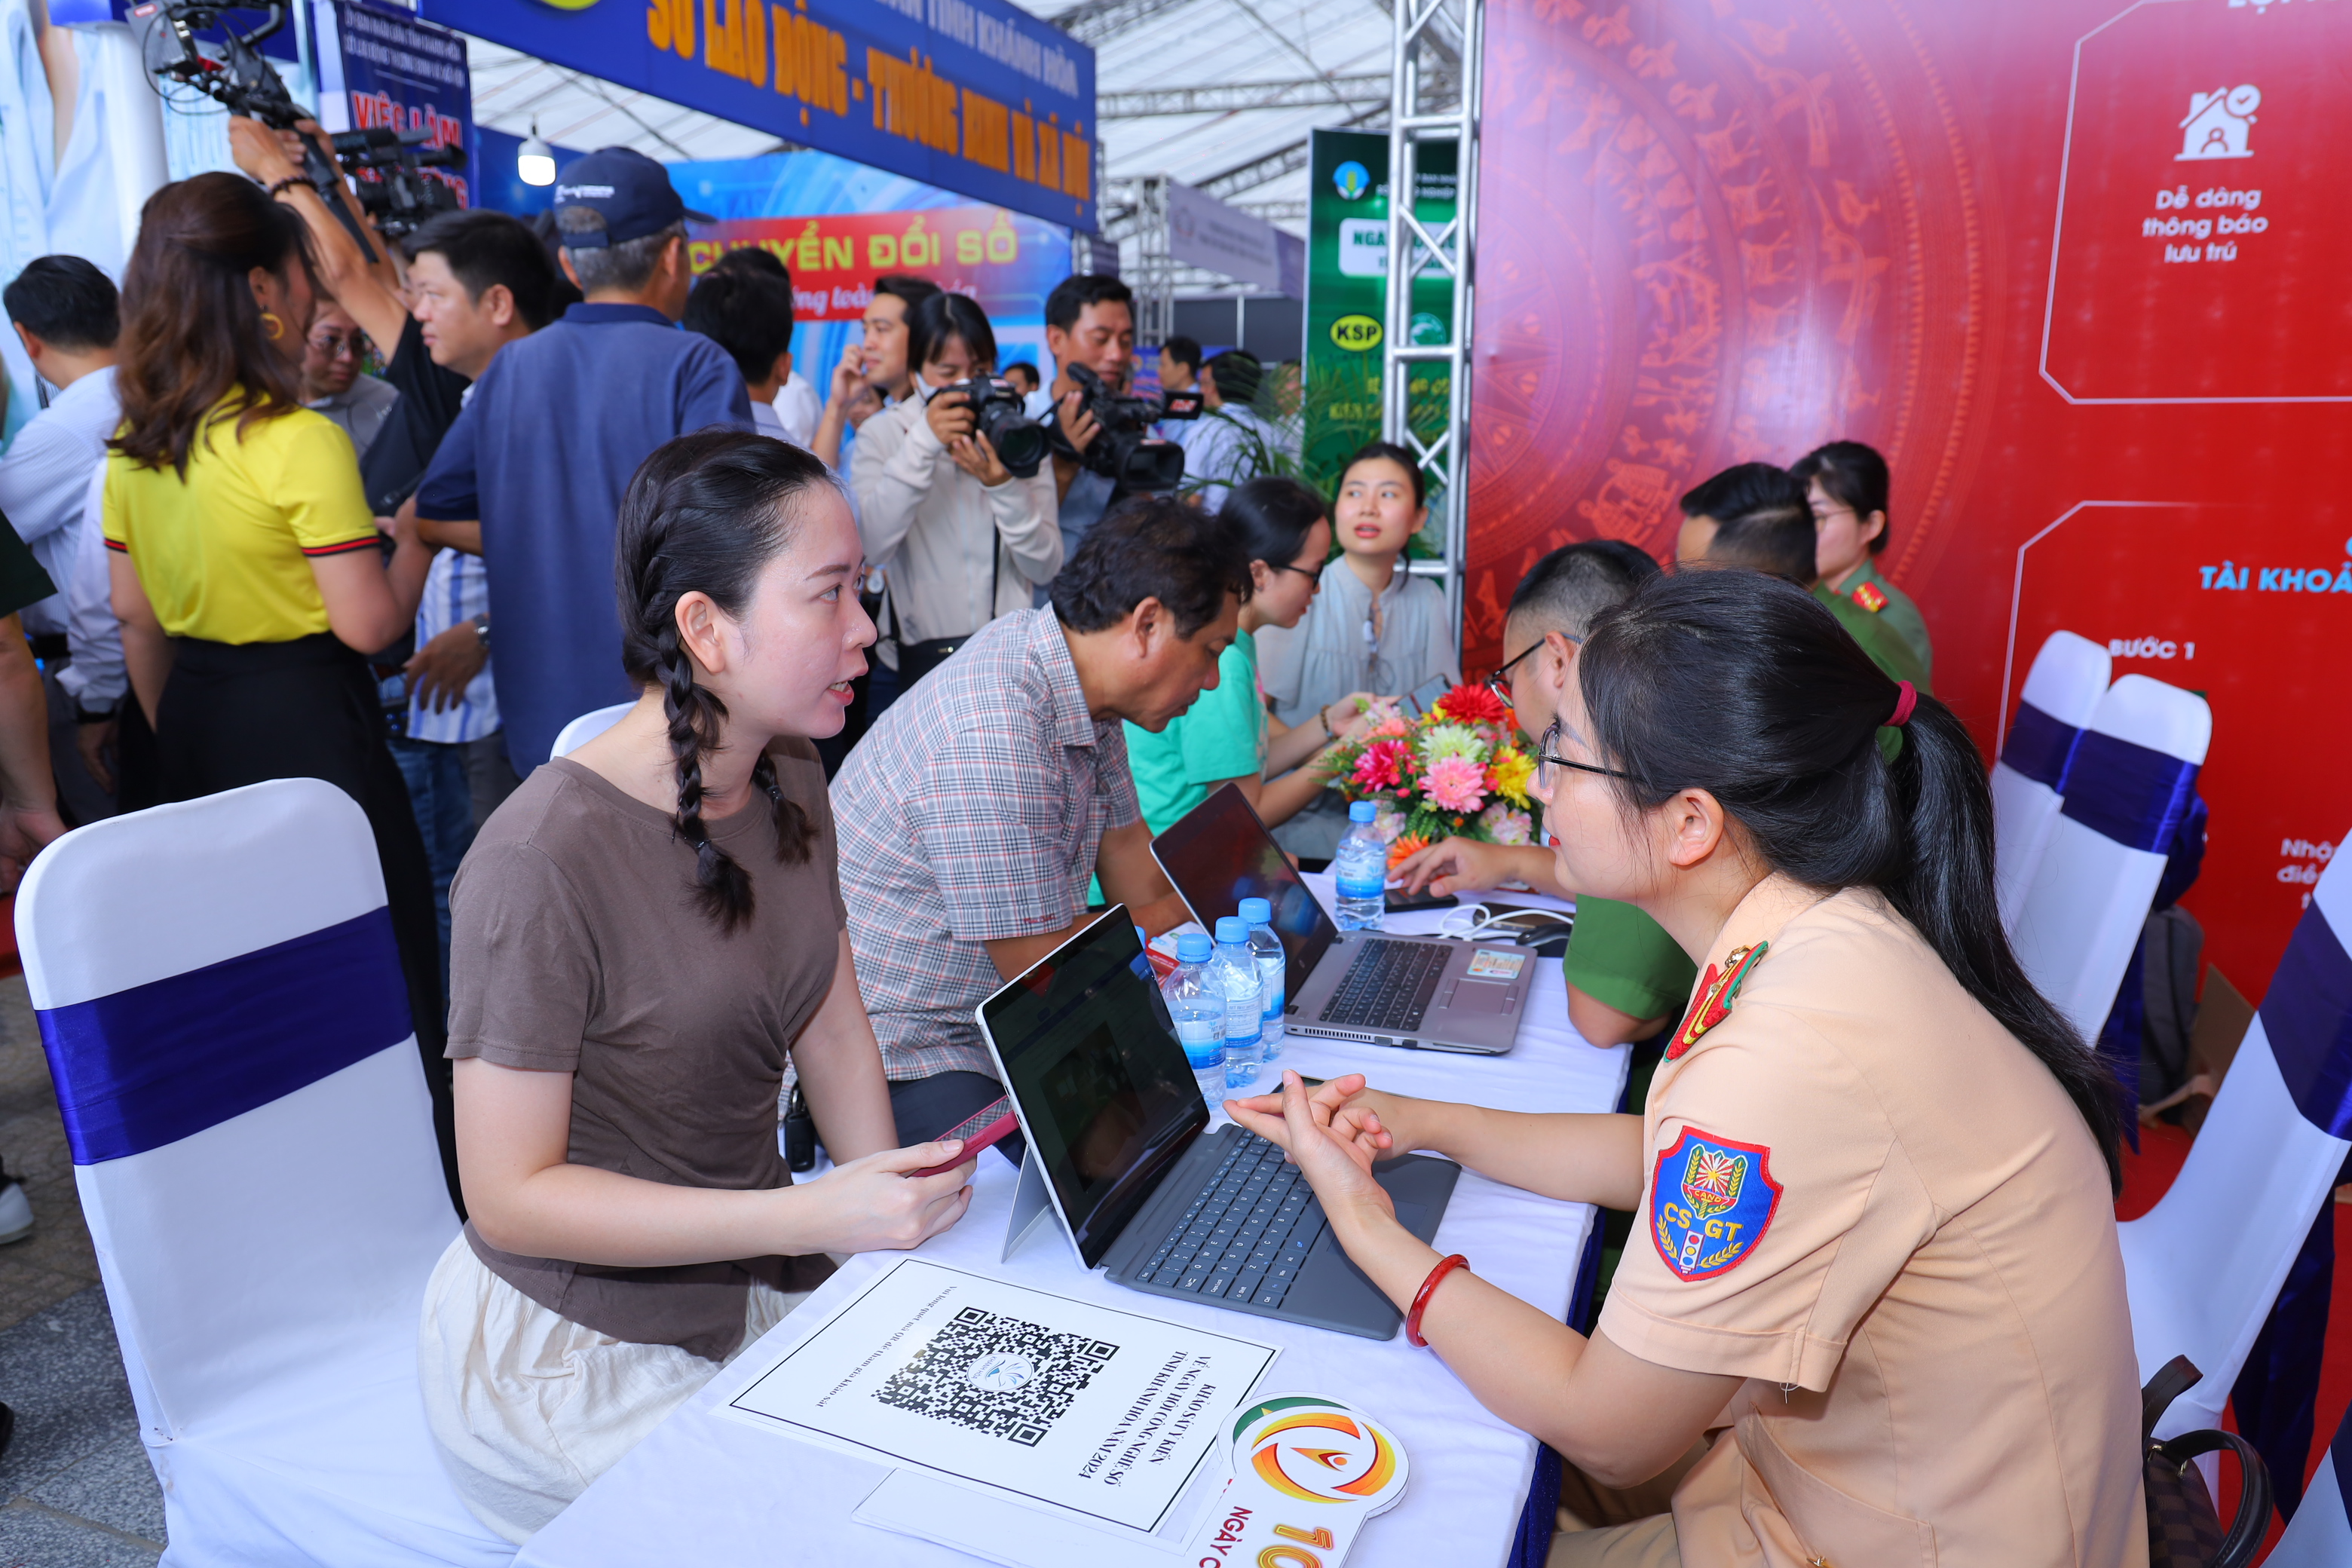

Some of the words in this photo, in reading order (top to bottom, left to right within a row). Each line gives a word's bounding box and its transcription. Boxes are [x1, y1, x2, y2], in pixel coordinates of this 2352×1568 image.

[2155, 185, 2189, 210] Dễ
[2195, 186, 2262, 211] dàng
[2142, 216, 2213, 239] thông
[2217, 213, 2268, 234] báo
[688, 219, 854, 275] CYỂN
[868, 215, 942, 268] ĐỔI
[957, 208, 1018, 265] SỐ
[2164, 243, 2201, 263] lưu
[2206, 240, 2237, 262] trú
[1337, 325, 1377, 341] KSP
[2199, 559, 2250, 590] TÀI
[2257, 561, 2352, 594] KHOẢ
[2110, 635, 2178, 659] BƯỚC
[2183, 642, 2196, 660] 1
[2280, 838, 2335, 864] Nhậ
[1694, 1190, 1723, 1203] CAND
[1664, 1202, 1693, 1230] CS
[1705, 1220, 1744, 1242] GT
[890, 1331, 904, 1343] QR
[860, 1349, 884, 1367] tham
[1162, 1351, 1189, 1373] TỈNH
[1193, 1356, 1211, 1369] VỀ
[849, 1365, 863, 1379] gia
[1174, 1366, 1202, 1395] NGÀY
[829, 1378, 853, 1396] khảo
[1136, 1372, 1171, 1407] KHÁNH
[1188, 1383, 1217, 1412] KHẢO
[815, 1395, 831, 1408] sát
[1159, 1392, 1183, 1412] HỘI
[1118, 1405, 1145, 1428] HÒA
[1138, 1411, 1168, 1440] CÔNG
[1174, 1410, 1196, 1432] SÁT
[1098, 1426, 1128, 1453] NĂM
[1168, 1432, 1184, 1440] Ý
[1113, 1439, 1147, 1470] NGHỆ
[1148, 1438, 1177, 1465] KIẾN
[1078, 1452, 1107, 1479] 2024
[1104, 1468, 1124, 1487] SỐ
[1210, 1506, 1253, 1556] NGÀY
